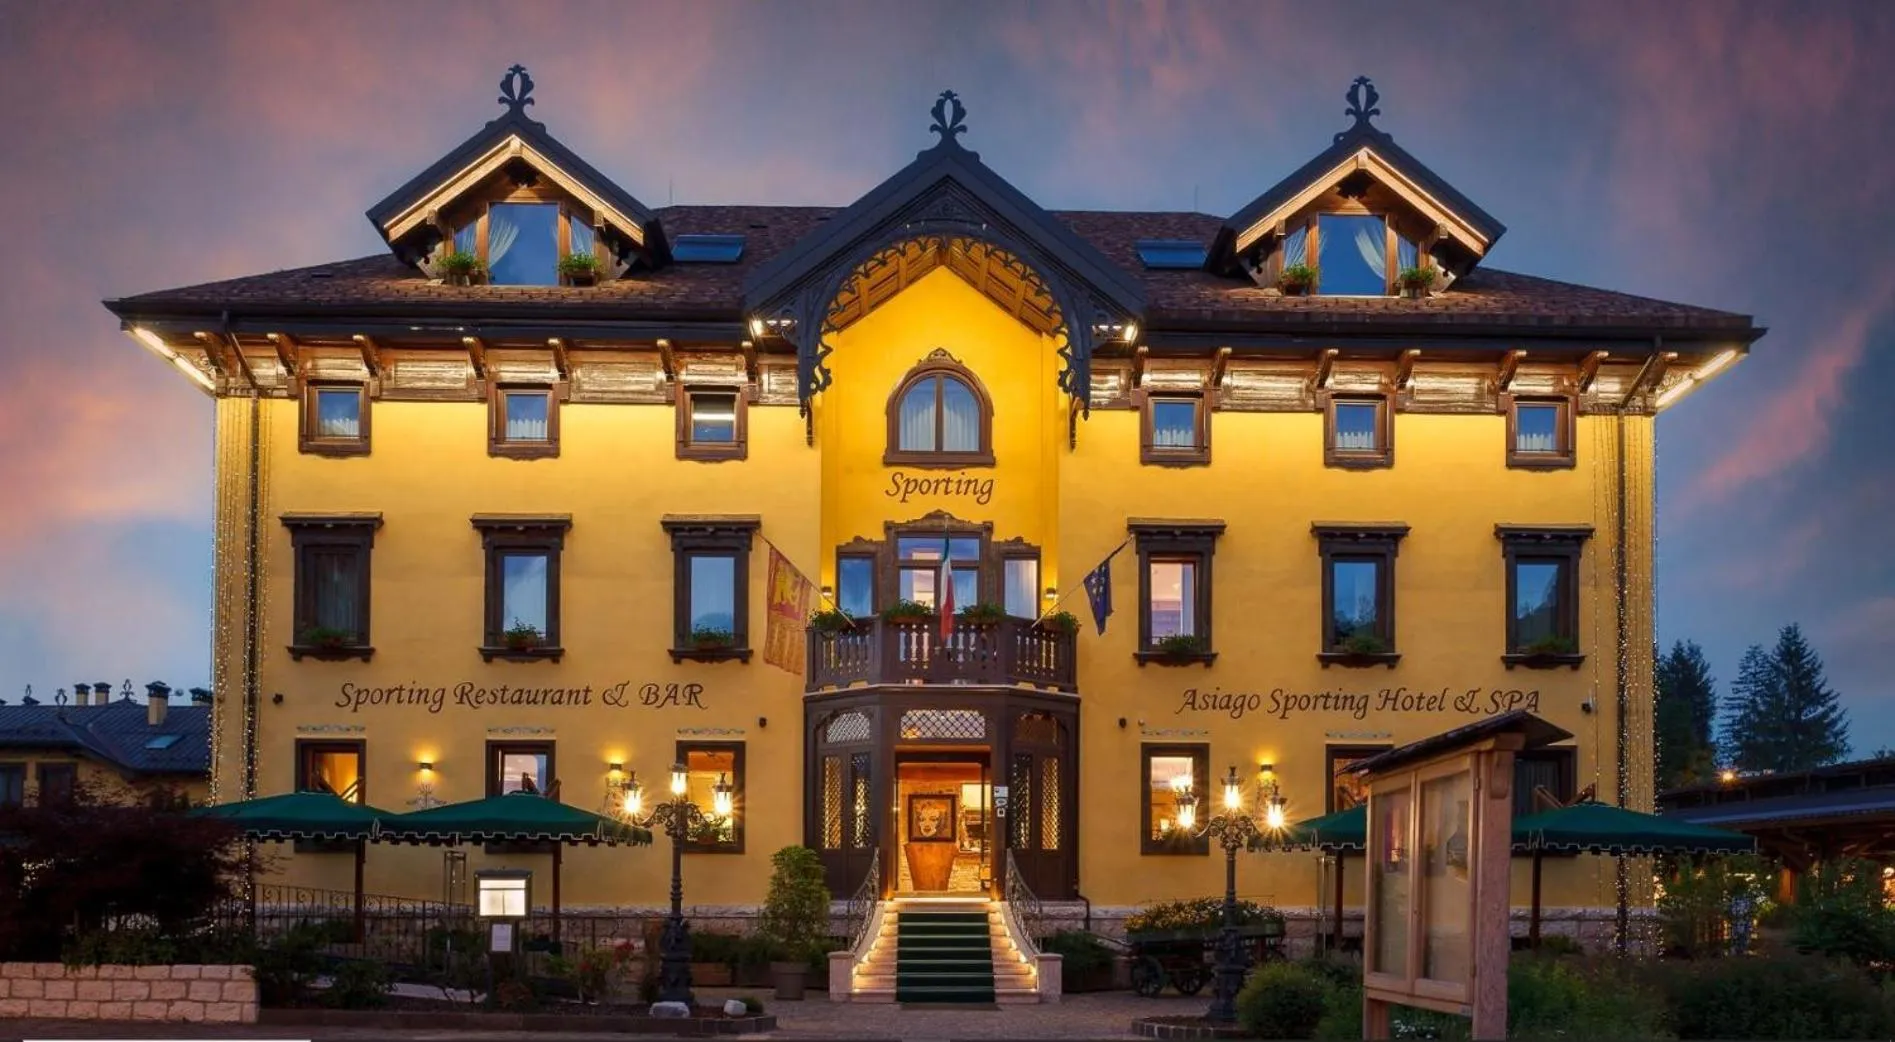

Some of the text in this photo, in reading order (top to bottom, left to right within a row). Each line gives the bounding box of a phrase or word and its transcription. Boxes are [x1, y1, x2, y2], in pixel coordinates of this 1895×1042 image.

[885, 472, 994, 505] Sporting
[335, 680, 708, 713] Sporting Restaurant & BAR
[1175, 688, 1540, 720] Asiago Sporting Hotel & SPA
